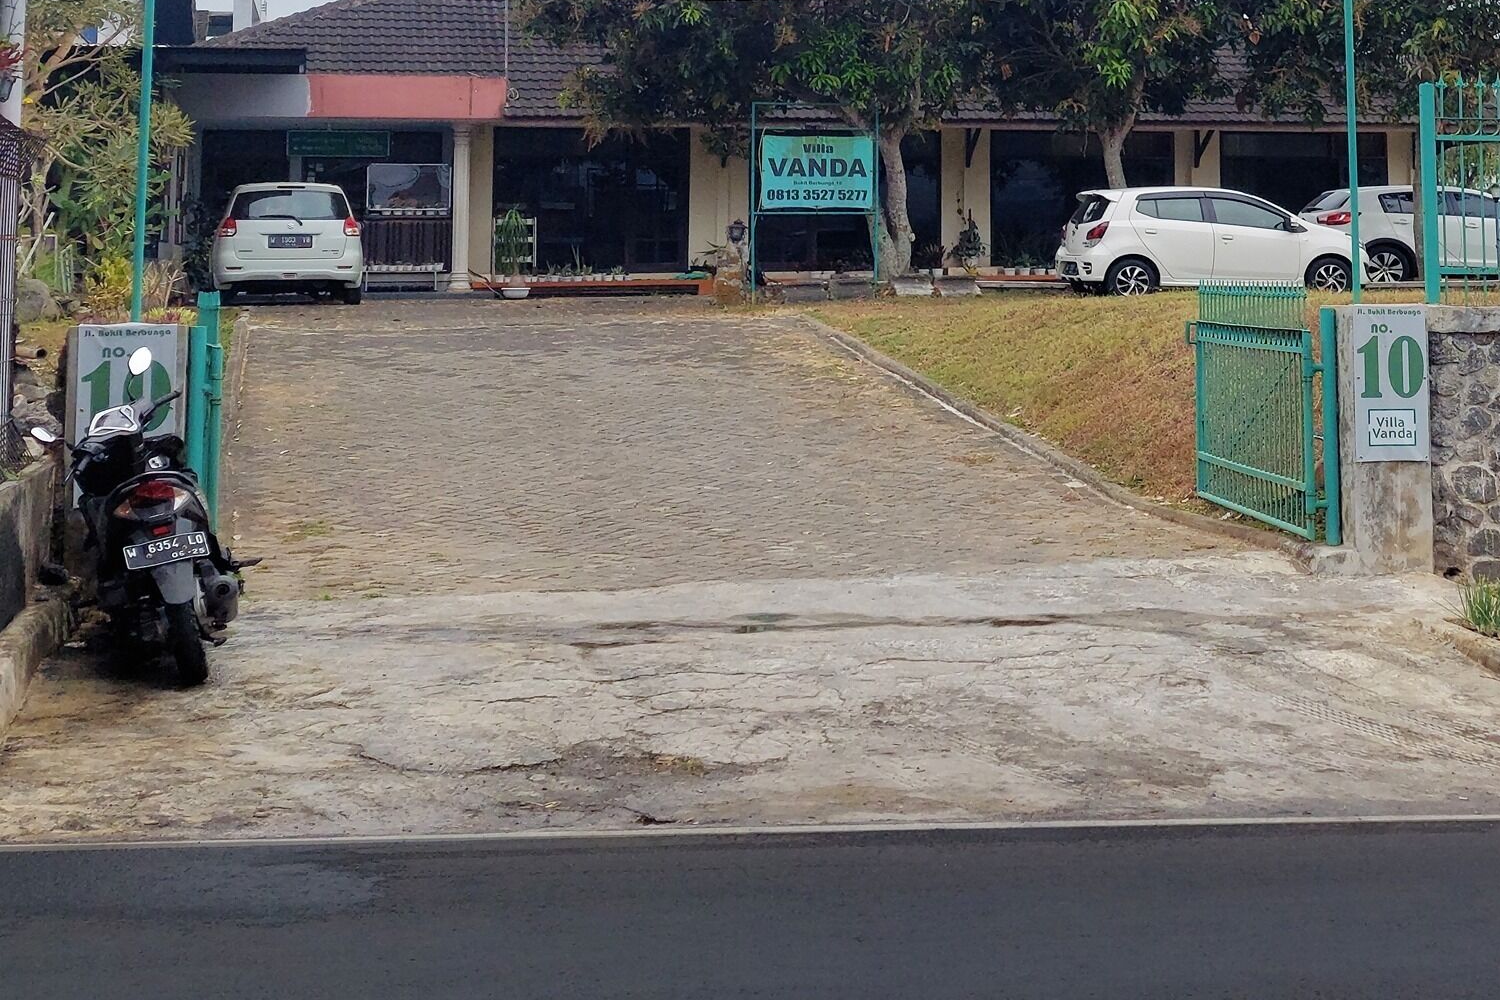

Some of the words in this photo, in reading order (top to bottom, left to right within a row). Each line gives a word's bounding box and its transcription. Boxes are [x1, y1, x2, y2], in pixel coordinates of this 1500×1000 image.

[803, 143, 834, 154] Villa
[768, 158, 868, 178] VANDA
[767, 189, 799, 201] 0813
[803, 190, 835, 201] 3527
[838, 190, 867, 201] 5277
[98, 329, 123, 337] Bukit
[1370, 323, 1393, 334] no.
[102, 347, 131, 358] no.
[1356, 335, 1424, 399] 10
[1376, 417, 1405, 428] Villa
[1372, 428, 1412, 439] Vanda
[126, 547, 137, 558] W
[148, 538, 180, 554] 6354
